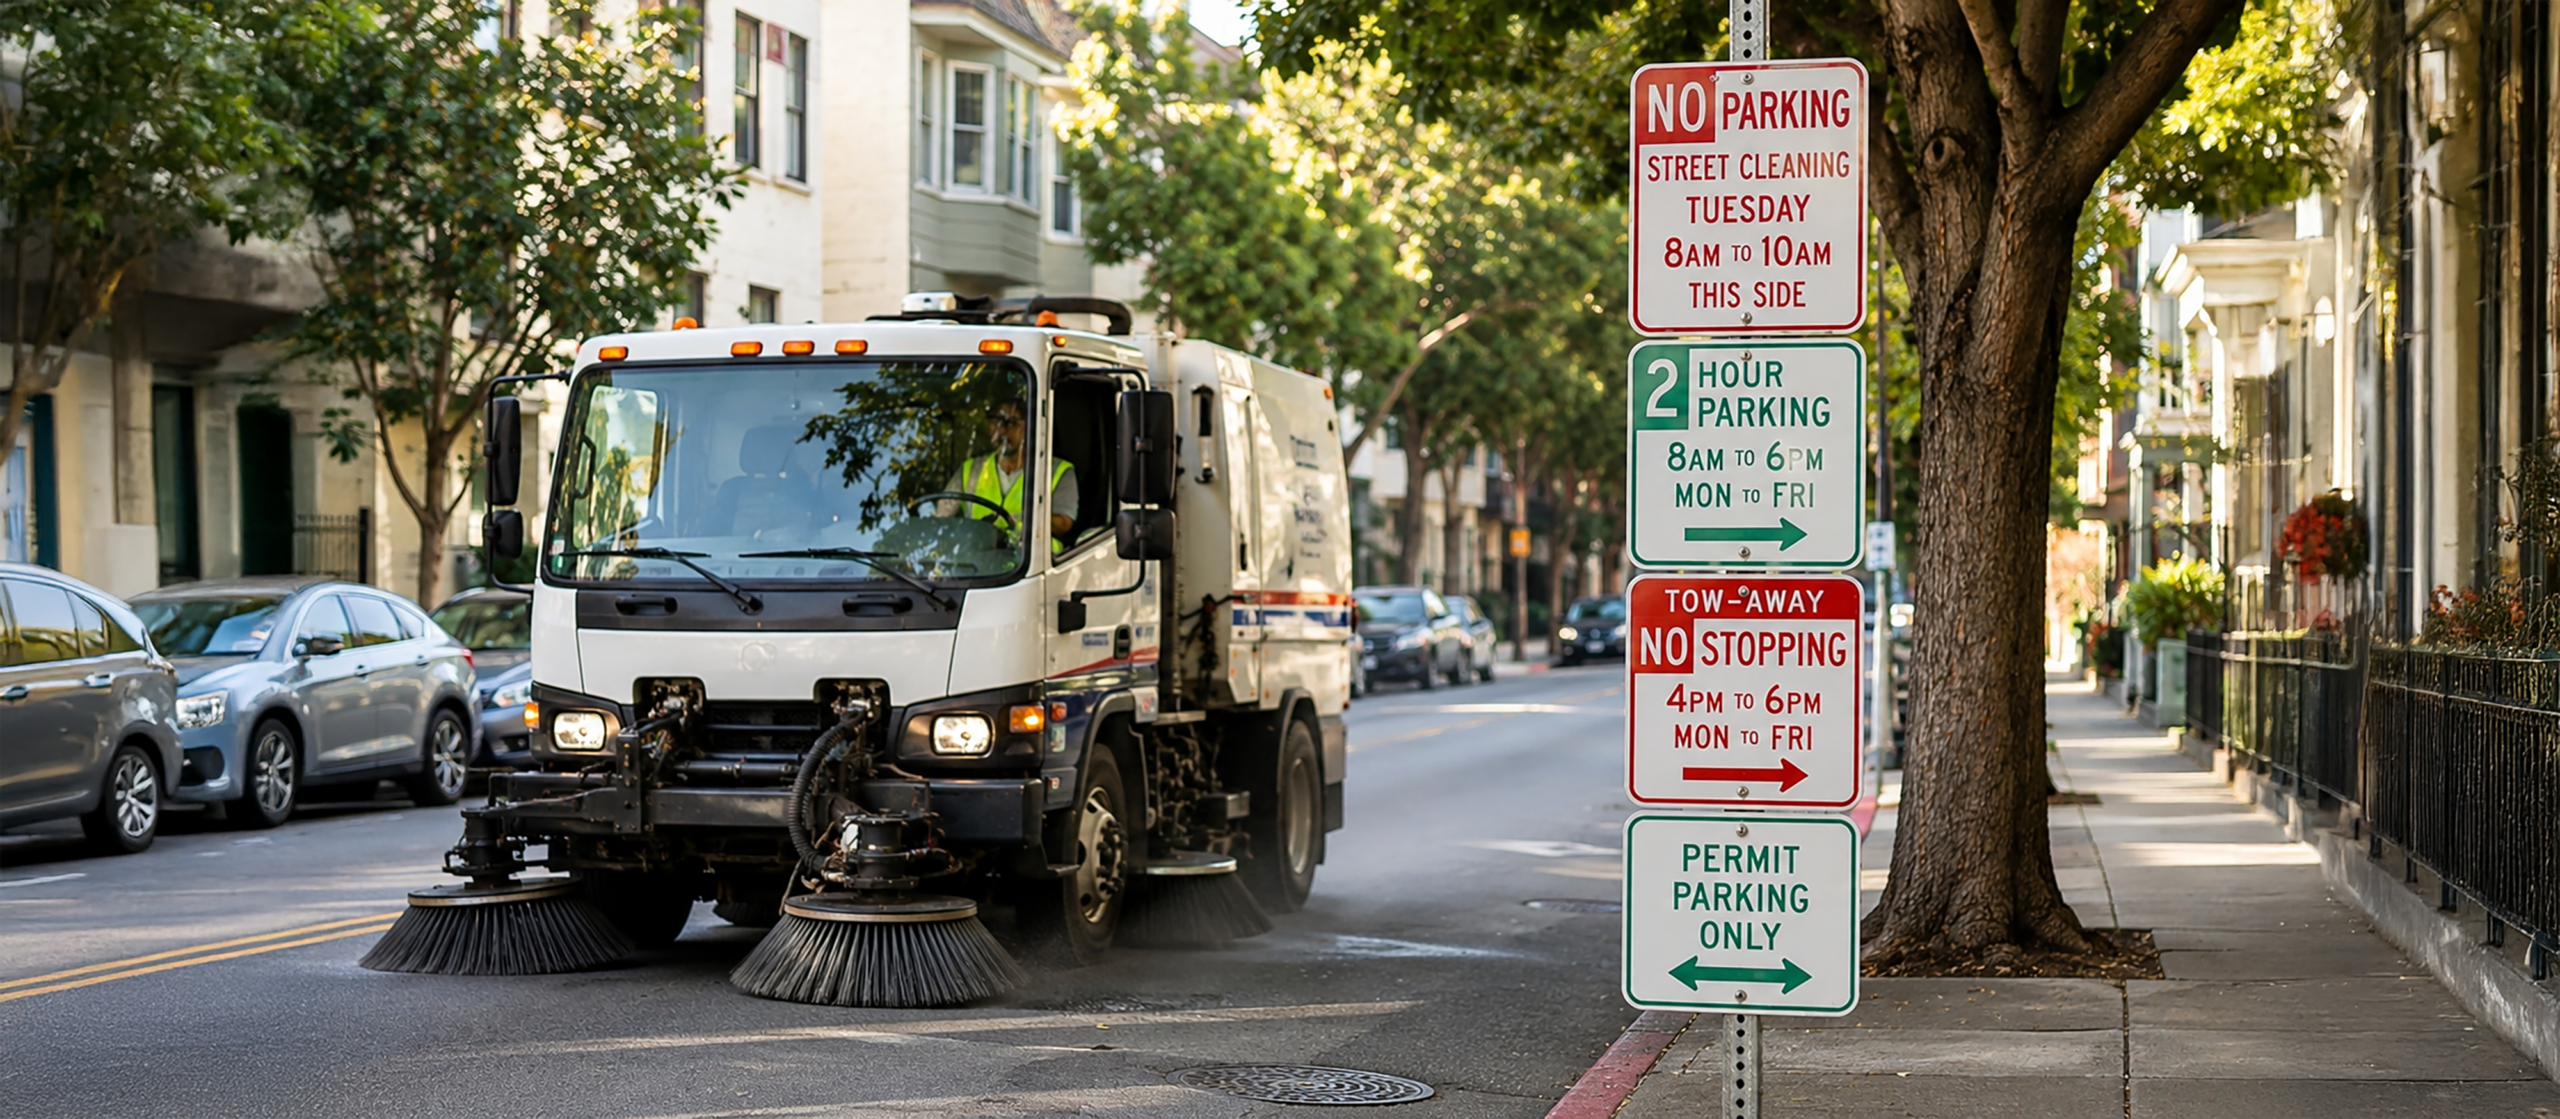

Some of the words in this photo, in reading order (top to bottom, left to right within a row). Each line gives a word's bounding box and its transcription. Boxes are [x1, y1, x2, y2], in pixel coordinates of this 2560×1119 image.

[1648, 82, 1707, 133] NO
[1723, 89, 1850, 130] PARKING
[1647, 154, 1729, 182] STREET
[1740, 151, 1849, 179] CLEANING
[1686, 195, 1810, 223] TUESDAY
[1664, 237, 1720, 268] 8AM
[1731, 245, 1751, 262] TO
[1762, 235, 1831, 266] 10AM
[1689, 282, 1741, 308] THIS
[1754, 281, 1806, 308] SIDE
[1646, 358, 1678, 418] 2
[1699, 361, 1783, 388] HOUR
[1699, 397, 1830, 427] PARKING
[1667, 441, 1724, 471] 8AM
[1735, 450, 1755, 466] TO
[1767, 441, 1823, 471] 6PM
[1676, 483, 1731, 508] MON
[1742, 489, 1760, 503] TO
[1774, 482, 1814, 508] FRI
[1665, 589, 1824, 613] TOW-AWAY
[1641, 627, 1688, 665] NO
[1702, 631, 1846, 667] STOPPING
[1667, 684, 1723, 713] 4PM
[1734, 693, 1754, 710] TO
[1765, 684, 1821, 714] 6PM
[1675, 724, 1729, 749] MON
[1741, 731, 1759, 745] TO
[1772, 725, 1813, 750] FRI
[1683, 844, 1799, 874] PERMIT
[1674, 881, 1809, 913] PARKING
[1700, 921, 1781, 951] ONLY
